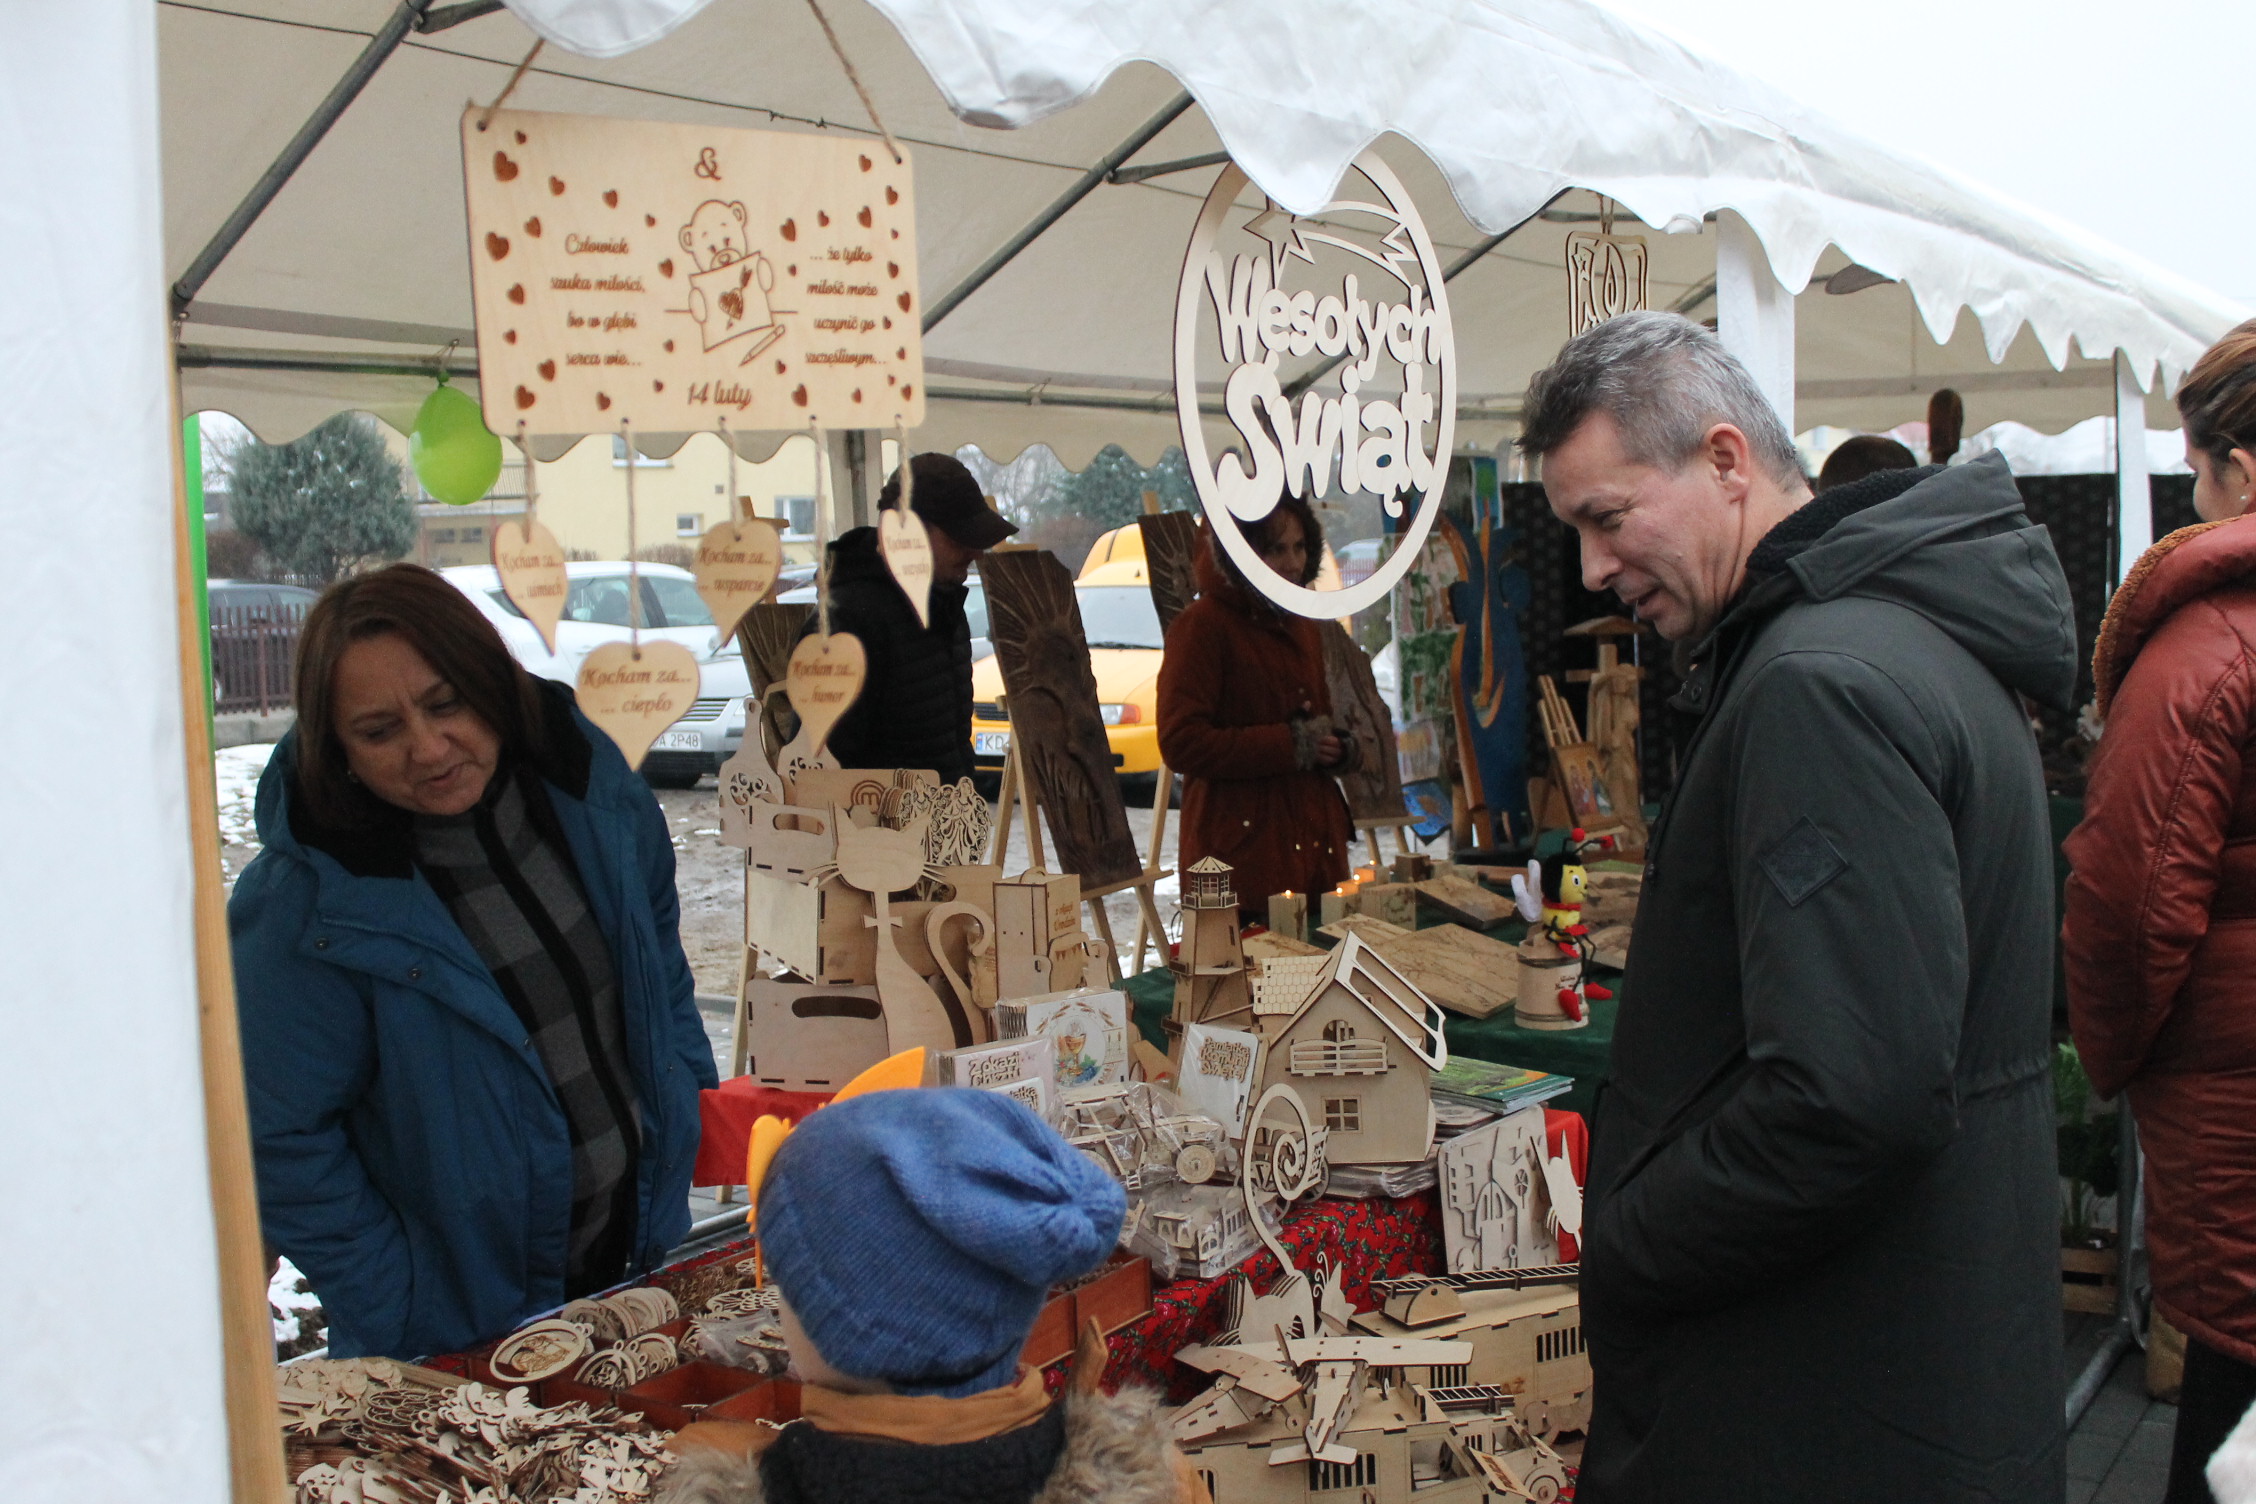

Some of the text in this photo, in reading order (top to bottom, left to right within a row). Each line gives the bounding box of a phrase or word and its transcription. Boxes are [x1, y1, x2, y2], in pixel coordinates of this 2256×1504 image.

[694, 147, 721, 181] &
[565, 233, 630, 255] Człowiek
[842, 246, 873, 265] tylko
[550, 273, 592, 290] szuka
[806, 279, 878, 296] miłość może
[860, 319, 876, 333] go
[1205, 250, 1441, 382] Wesołych
[687, 379, 753, 411] 14 luty
[1217, 348, 1434, 522] Świąt
[501, 550, 541, 574] Kocham
[700, 546, 745, 567] Kocham
[581, 665, 653, 689] Kocham
[793, 657, 833, 680] Kocham
[621, 691, 674, 718] ciepło
[671, 734, 699, 747] 2P48
[985, 735, 1004, 751] KD
